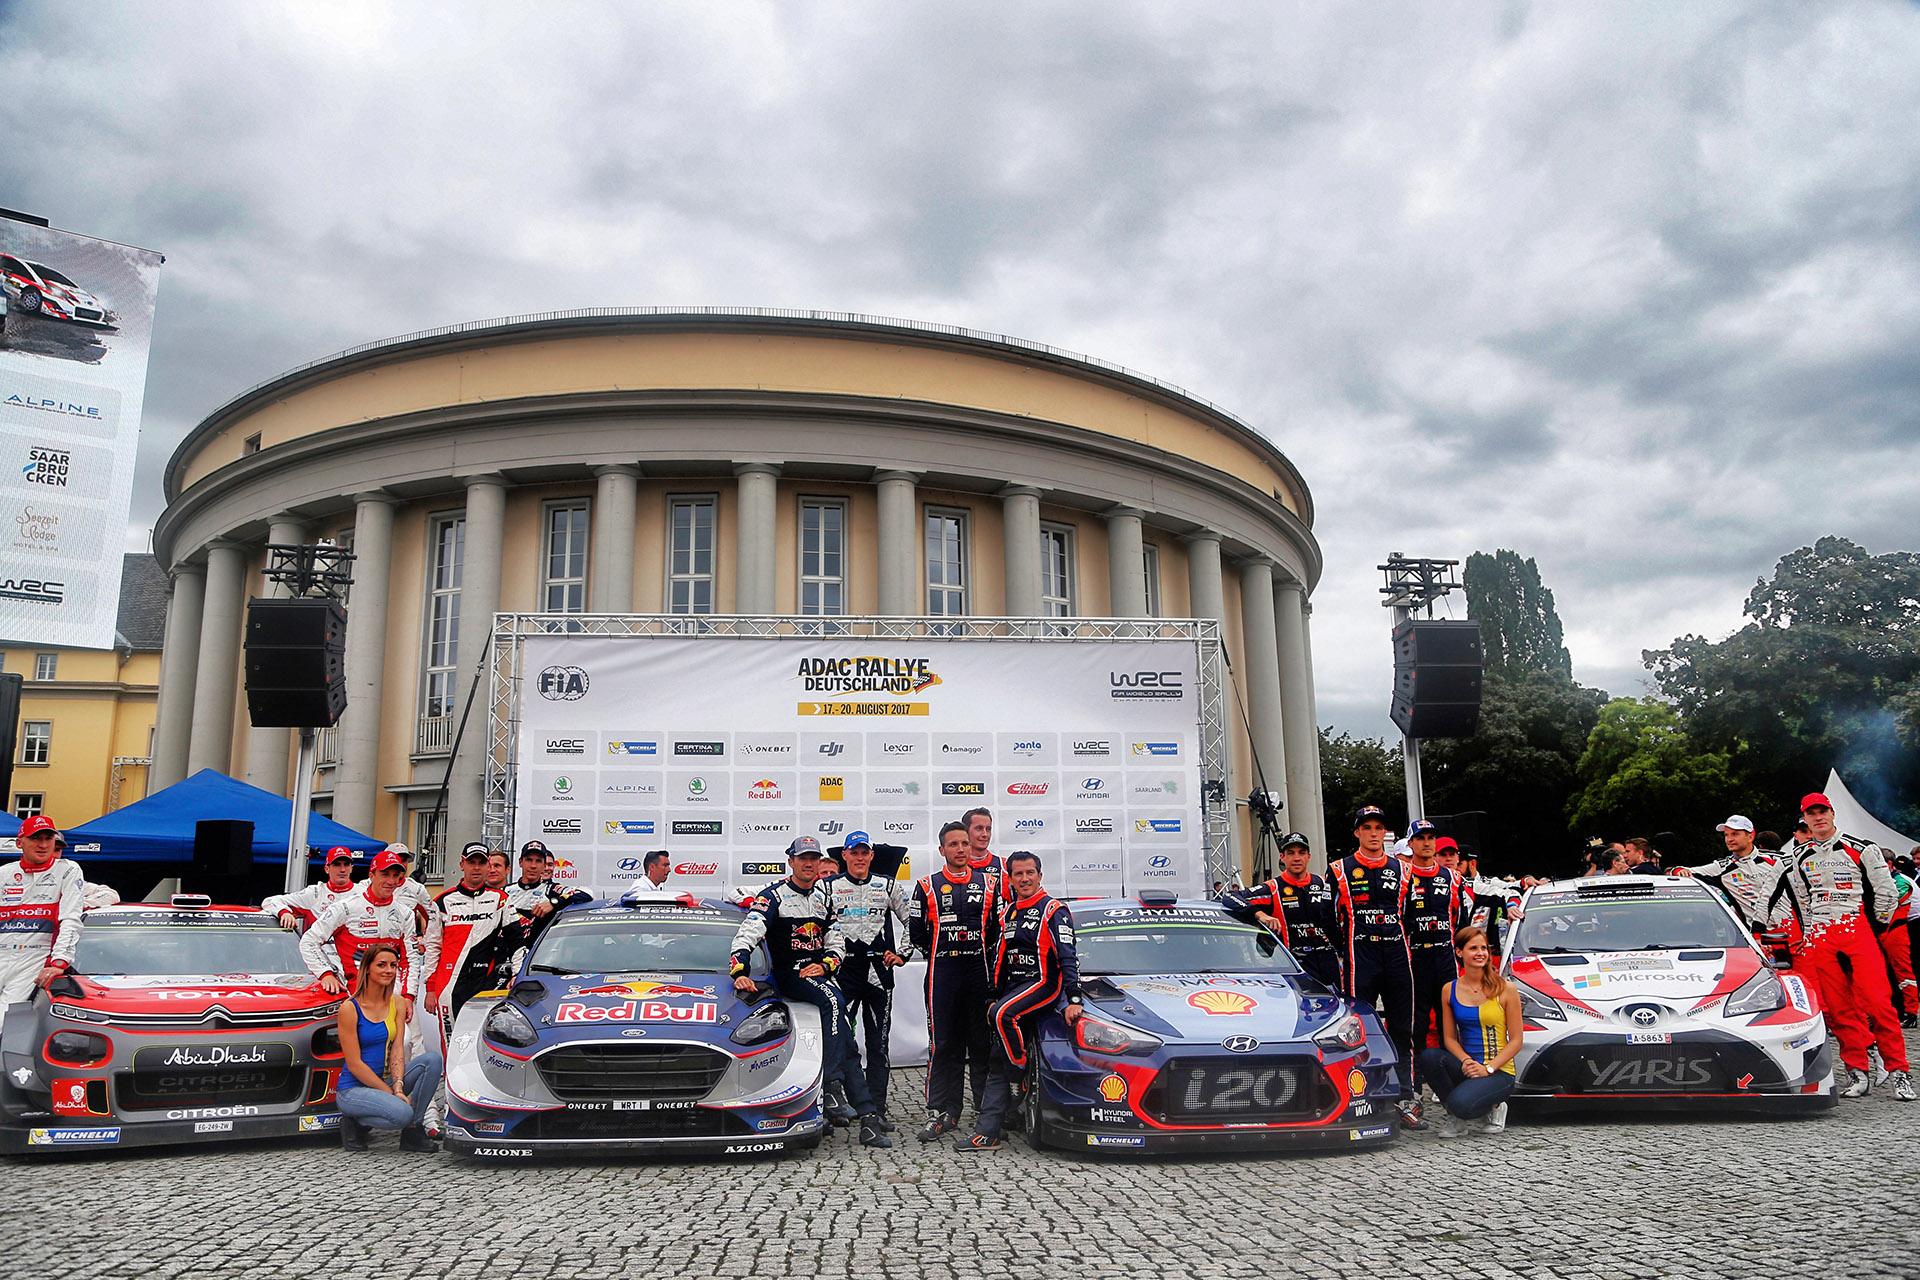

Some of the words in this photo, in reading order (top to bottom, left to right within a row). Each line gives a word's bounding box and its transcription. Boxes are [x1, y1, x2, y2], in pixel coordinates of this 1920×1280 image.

[8, 394, 100, 416] ALPINE
[29, 450, 70, 465] SAAR
[37, 462, 69, 476] BRÜ
[26, 472, 67, 487] CKEN
[798, 658, 851, 676] ADAC
[856, 658, 929, 677] RALLYE
[1111, 671, 1183, 687] WRC
[805, 677, 911, 692] DEUTSCHLAND
[856, 704, 889, 715] AUGUST
[891, 704, 911, 715] 2017
[546, 739, 585, 748] WRC
[884, 743, 914, 752] Lexar
[1073, 741, 1110, 749] WRC
[950, 746, 982, 754] tamaggo
[821, 778, 843, 786] ADAC
[958, 785, 981, 793] OPEL
[1007, 782, 1050, 795] Eibach
[748, 791, 765, 799] Red
[766, 791, 782, 799] Bull
[543, 819, 582, 827] WRC
[884, 821, 914, 831] Lexar
[1076, 818, 1113, 827] WRC
[675, 862, 719, 875] Eibach
[758, 864, 783, 873] OPEL
[561, 870, 578, 879] Bull
[1138, 908, 1220, 917] HYUNDAI
[1160, 916, 1211, 924] Championship
[1365, 914, 1397, 924] MOBIS
[1419, 920, 1450, 931] MOBIS
[948, 930, 980, 941] MOBIS
[791, 939, 814, 950] Red
[1600, 951, 1663, 959] DENSO
[1608, 973, 1704, 983] Microsoft
[1179, 978, 1287, 989] MOBIS
[148, 990, 278, 1000] TOTAL
[557, 1001, 635, 1021] Red
[641, 1002, 717, 1022] Bull
[1566, 1004, 1584, 1013] DMG
[1584, 1009, 1605, 1020] MORI
[1686, 1007, 1703, 1018] DMG
[1703, 1000, 1721, 1011] MORI
[1184, 1068, 1297, 1110] i20
[568, 1102, 607, 1110] ONEBET
[621, 1102, 637, 1110] WRT
[656, 1102, 696, 1110] ONEBET
[167, 1105, 258, 1119] CITROËN
[481, 1123, 503, 1132] Castrol
[765, 1119, 787, 1128] Castrol
[54, 1130, 118, 1140] MICHELIN
[1362, 1128, 1390, 1136] MICHELIN
[474, 1147, 533, 1157] AZIONE
[724, 1142, 784, 1153] AZIONE
